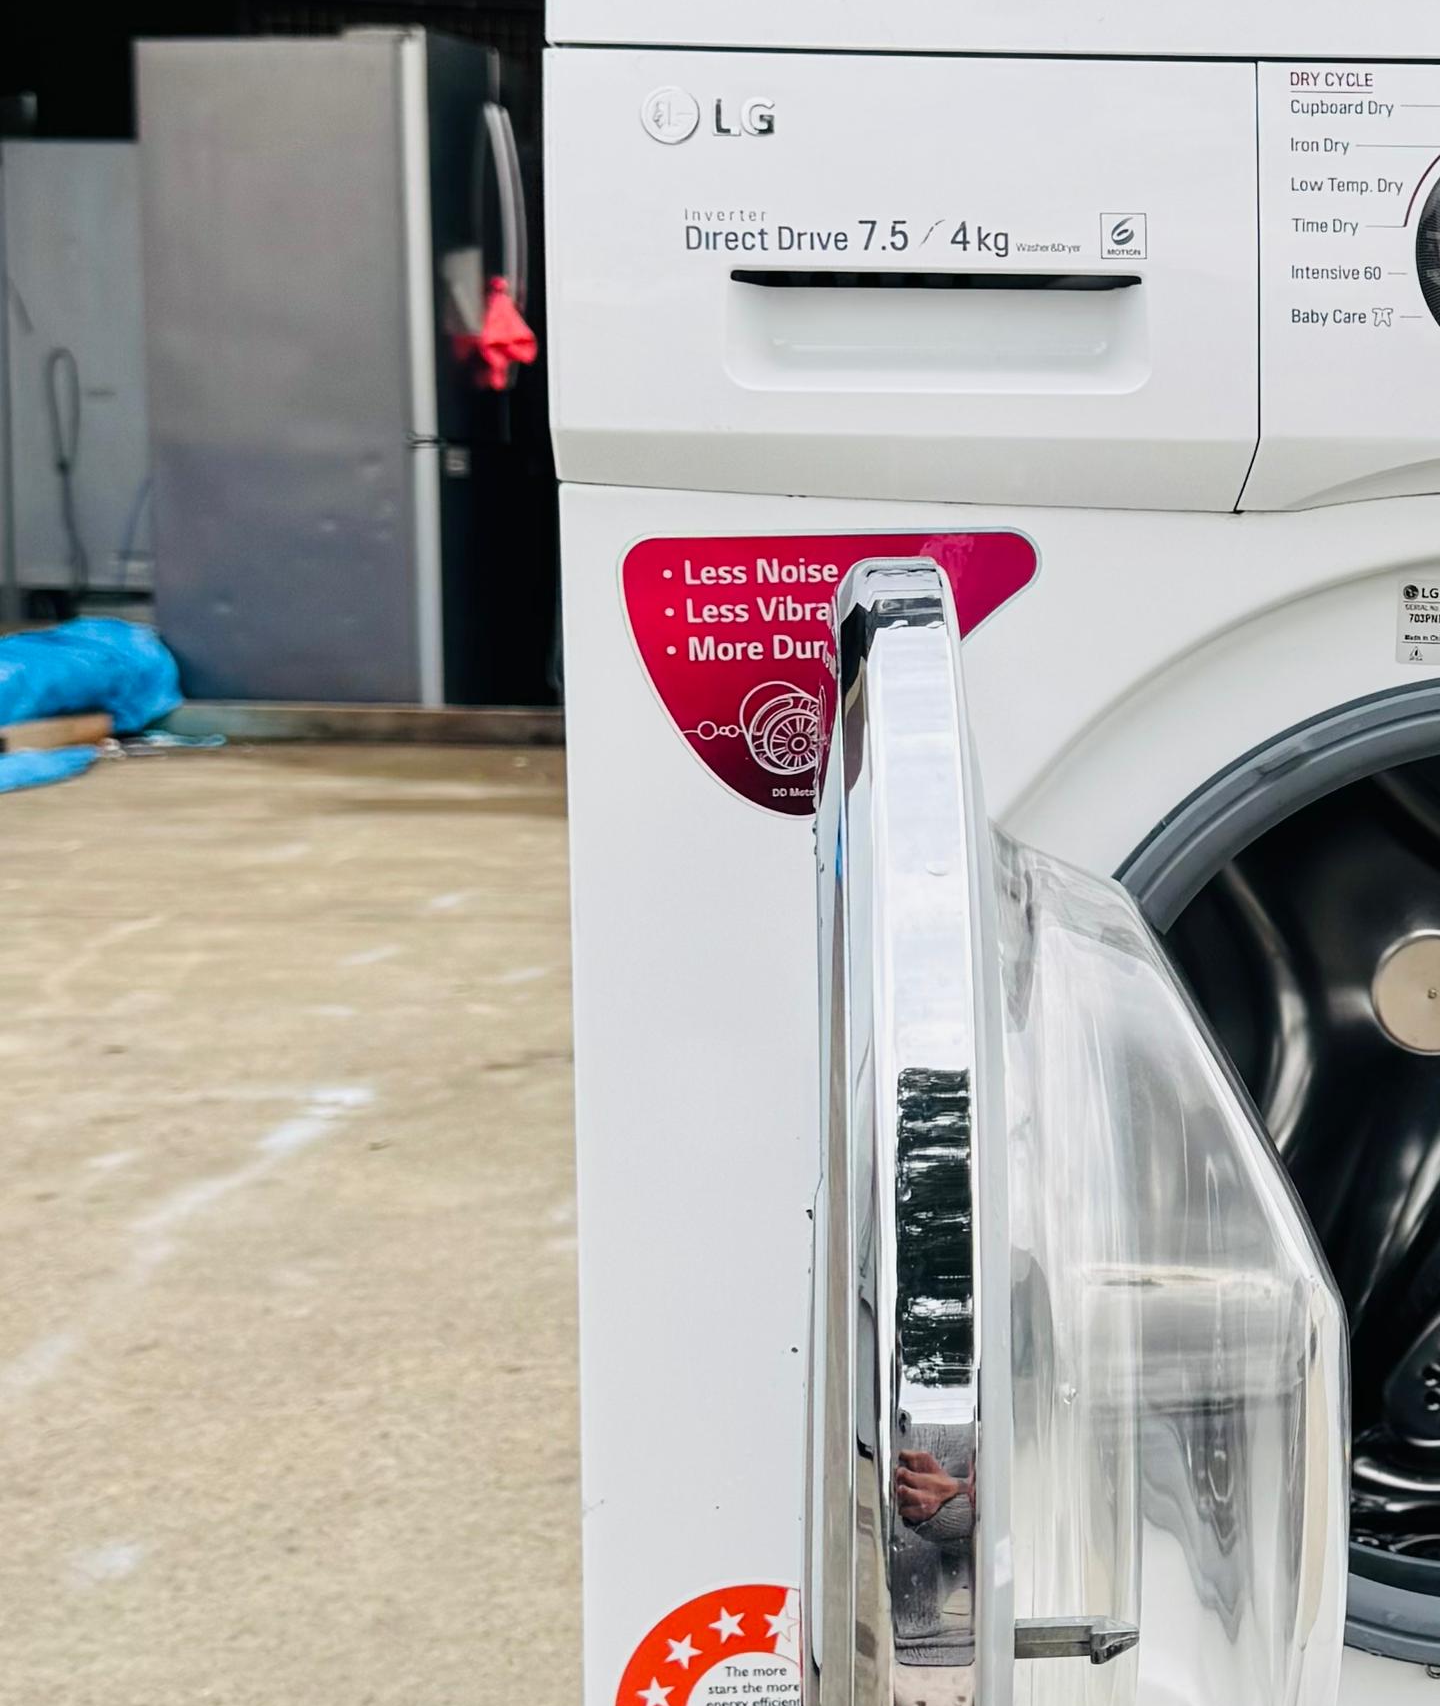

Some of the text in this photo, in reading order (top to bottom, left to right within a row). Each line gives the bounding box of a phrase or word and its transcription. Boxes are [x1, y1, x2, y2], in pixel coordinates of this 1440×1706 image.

[1290, 72, 1373, 88] DRY CYCLE
[1290, 100, 1394, 117] Cupboard Dry
[712, 97, 776, 137] LG
[1290, 138, 1350, 154] Iron Dry
[1291, 178, 1404, 196] Low Temp. Dry
[684, 208, 767, 222] Inverter
[1291, 218, 1358, 236] Time Dry
[685, 226, 769, 251] Direct
[778, 226, 848, 251] Drive
[858, 220, 909, 252] 7.5
[950, 221, 971, 251] 4
[977, 226, 1009, 258] kg
[1107, 248, 1141, 256] MOTION
[1291, 265, 1382, 281] Intensive 60
[1291, 308, 1367, 327] Baby Care
[684, 557, 839, 585] Less Noise
[1421, 588, 1439, 598] LG
[686, 595, 831, 624] Less Vibra
[689, 634, 828, 662] More Dur
[772, 787, 816, 797] DD Moto
[725, 1666, 787, 1677] The more
[708, 1682, 801, 1694] stars the more
